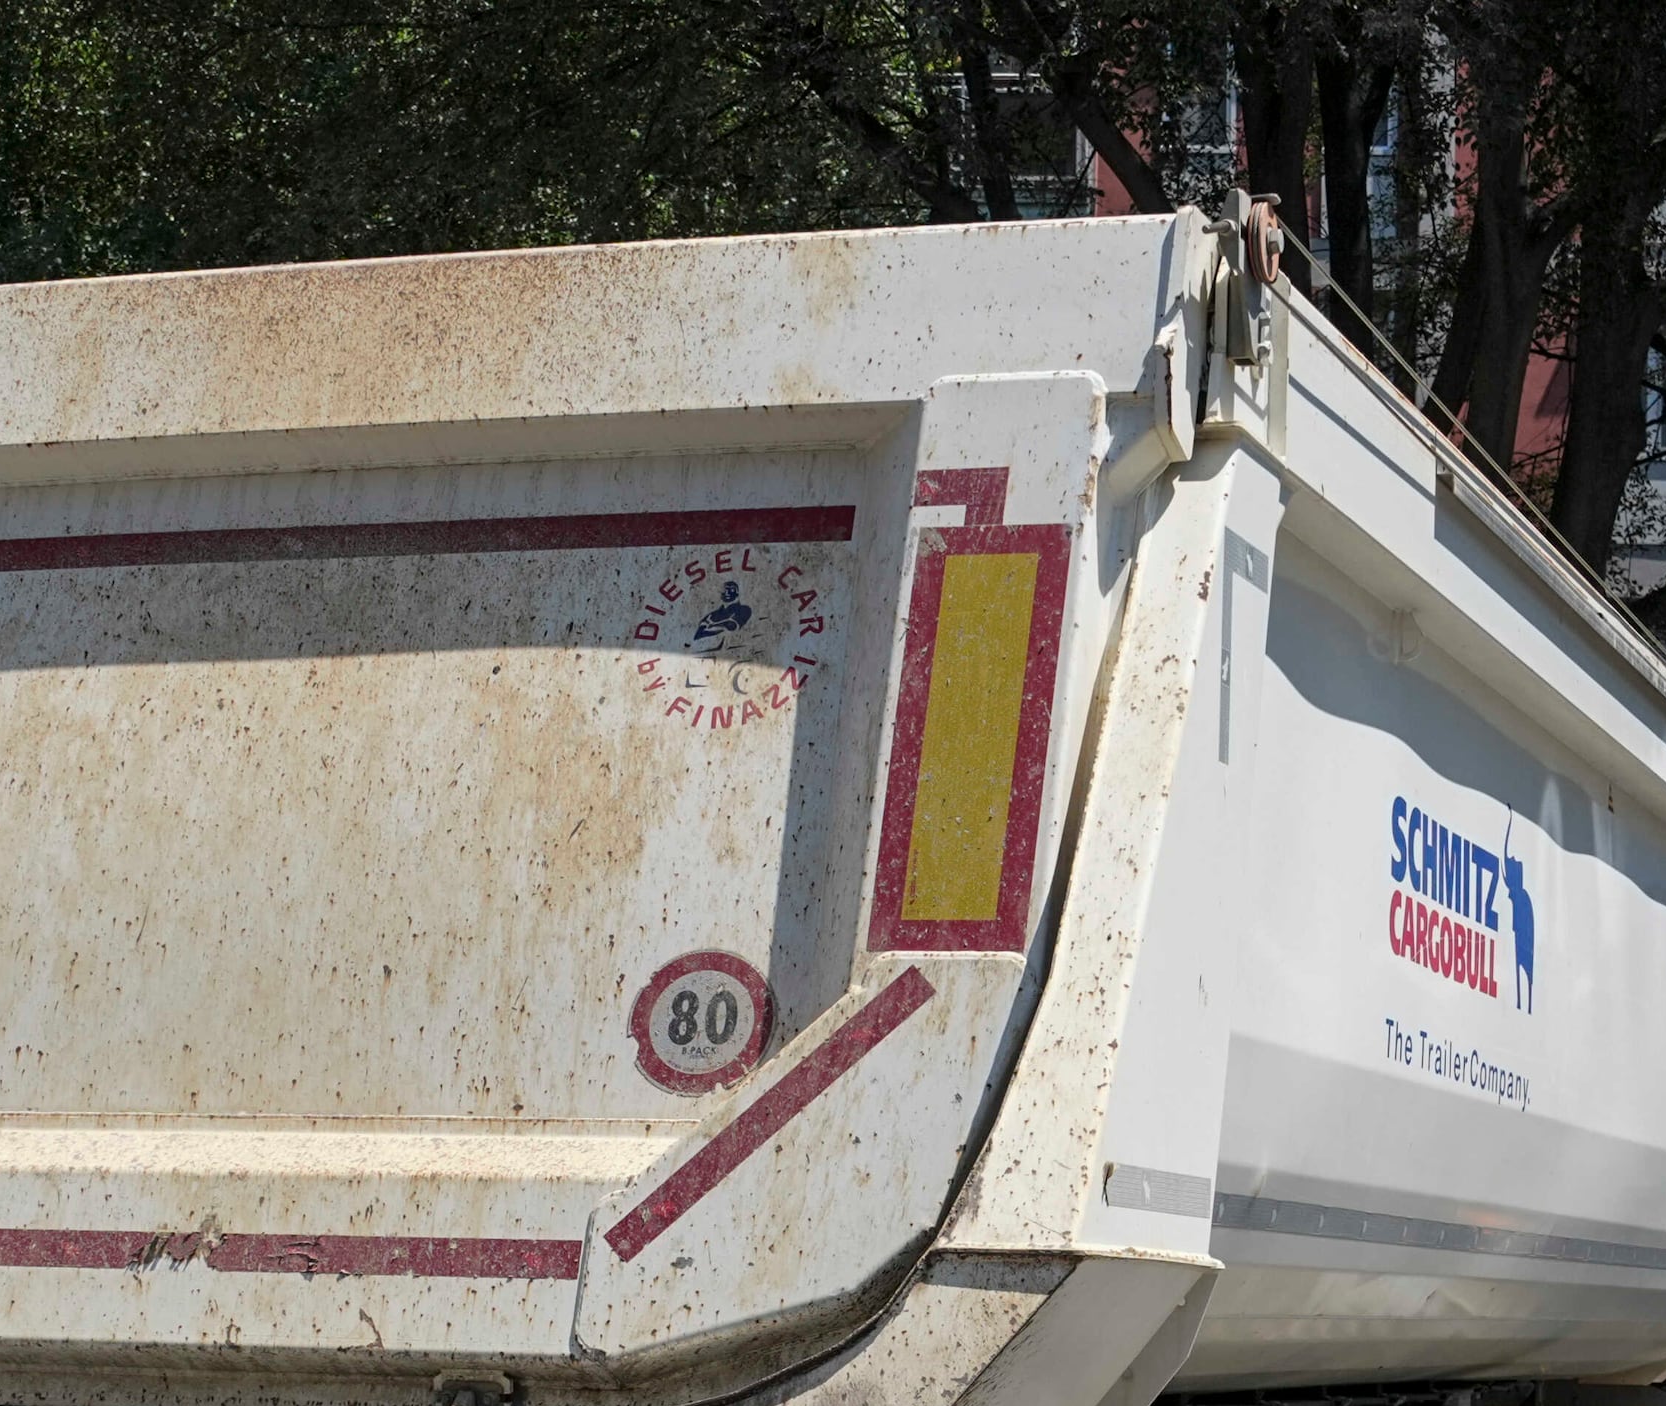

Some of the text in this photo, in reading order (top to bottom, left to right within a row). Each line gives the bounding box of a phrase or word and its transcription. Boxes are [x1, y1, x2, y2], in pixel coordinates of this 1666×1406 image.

[634, 549, 824, 641] DIESEL CAR
[665, 655, 817, 729] FINAZZI
[1391, 795, 1500, 933] SCHMITZ
[1389, 889, 1498, 999] CARGOBULL
[668, 990, 739, 1046] 80
[1385, 1018, 1413, 1066] The
